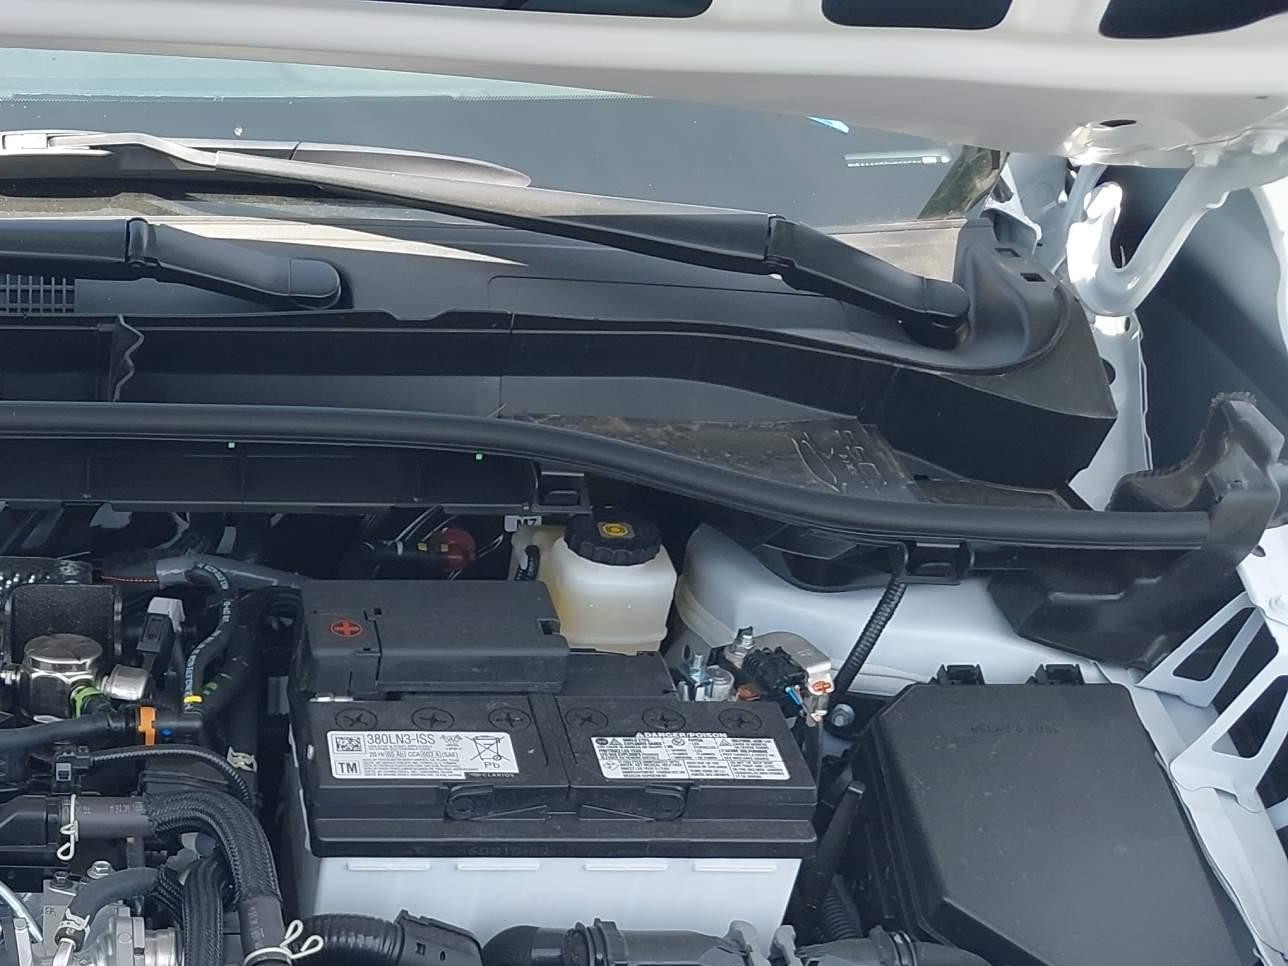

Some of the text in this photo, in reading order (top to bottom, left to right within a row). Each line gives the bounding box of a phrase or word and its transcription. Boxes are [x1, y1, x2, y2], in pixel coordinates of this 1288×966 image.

[367, 733, 436, 745] 380LN3-ISS
[338, 762, 358, 774] TM
[484, 761, 501, 769] Pb
